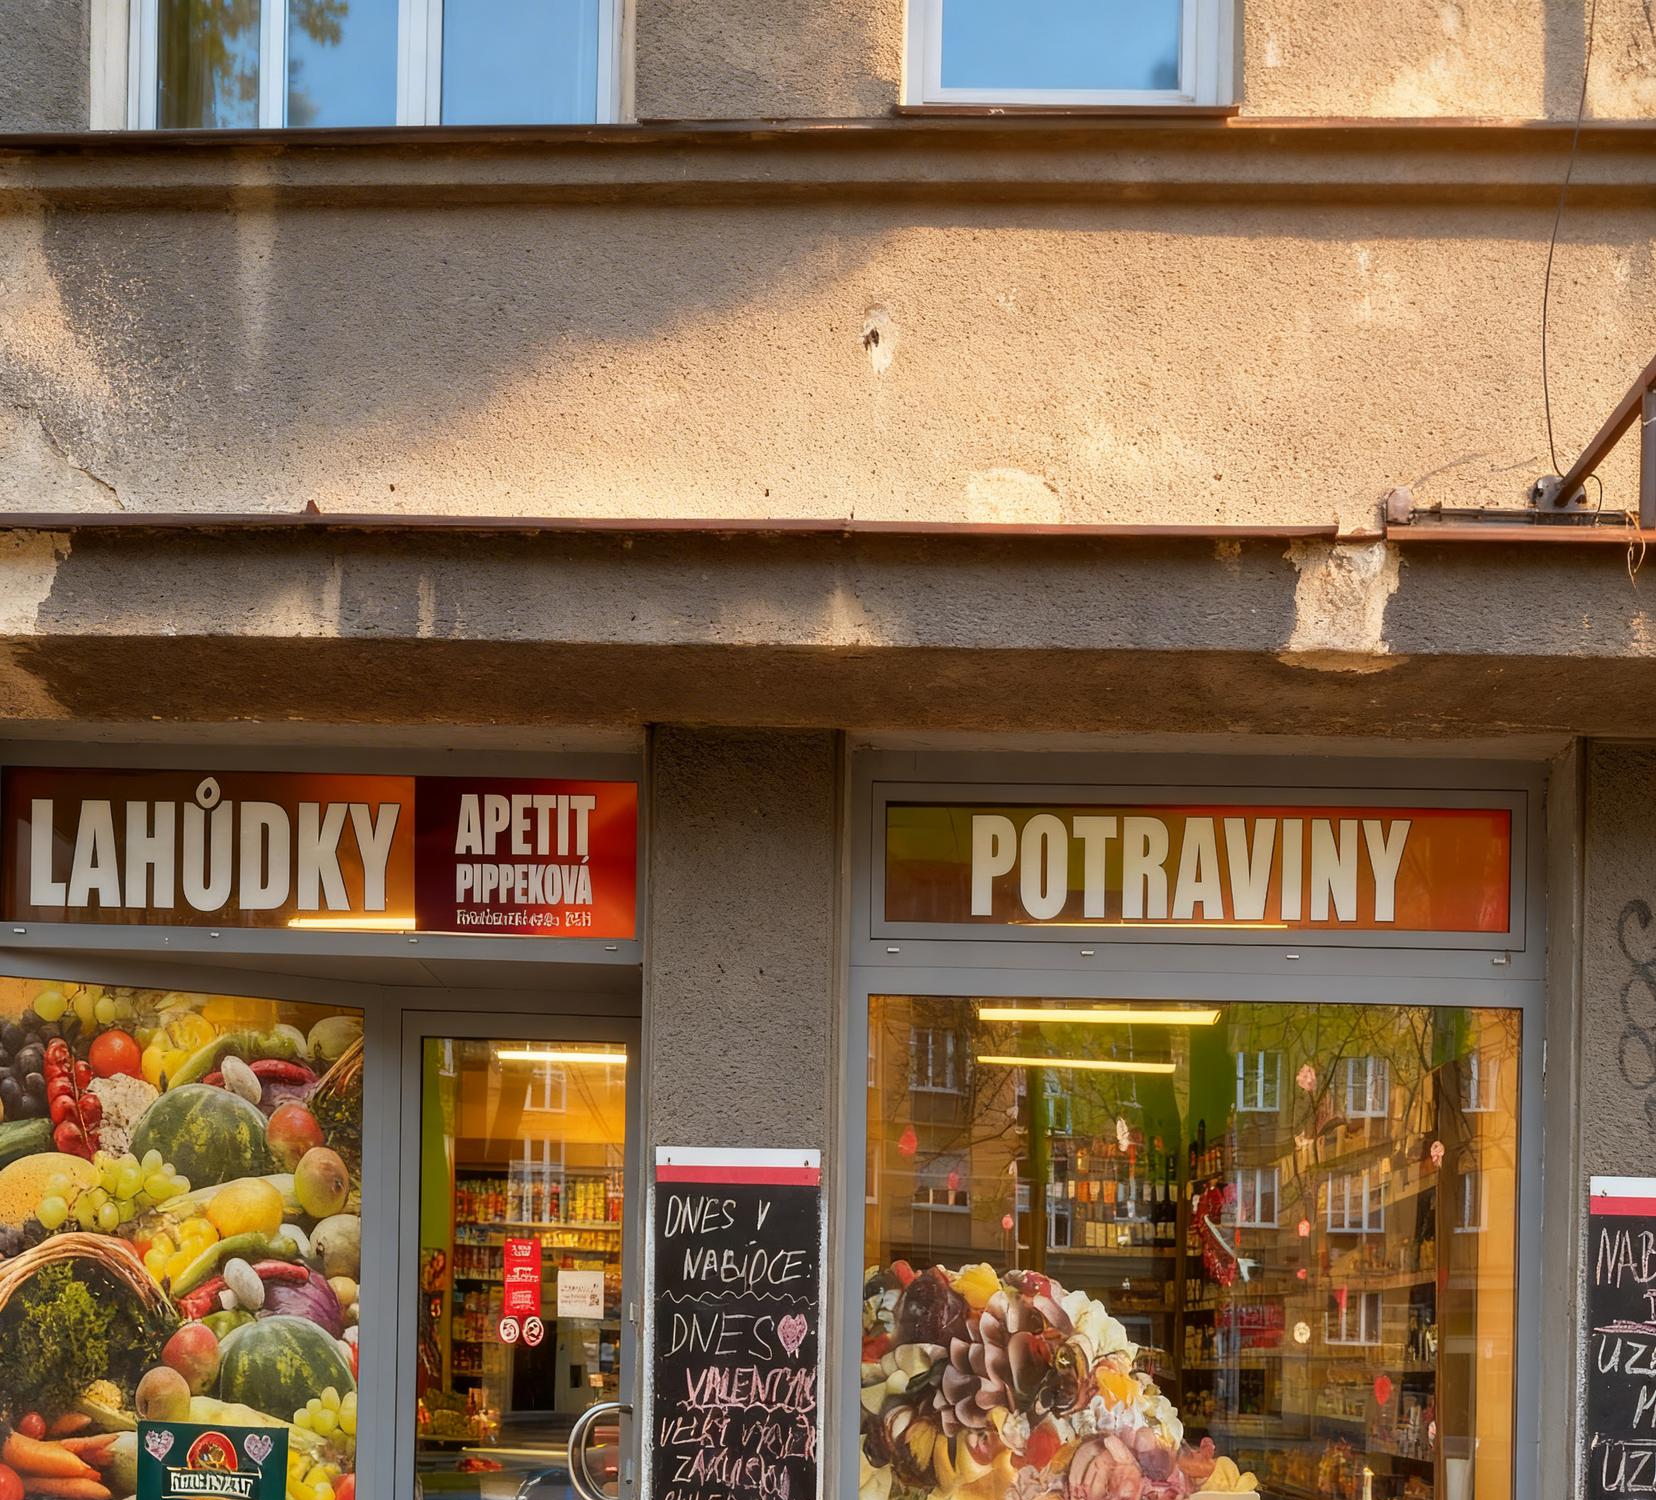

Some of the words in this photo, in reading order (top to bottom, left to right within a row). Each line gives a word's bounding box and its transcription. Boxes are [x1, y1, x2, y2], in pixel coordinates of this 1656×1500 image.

[30, 777, 401, 912] LAHŮDKY
[455, 794, 596, 856] APETIT
[456, 856, 593, 905] PIPPEKOVÁ
[970, 813, 1412, 923] POTRAVINY
[664, 1195, 737, 1238] DNES
[757, 1199, 771, 1231] V
[663, 1312, 775, 1361] DNES
